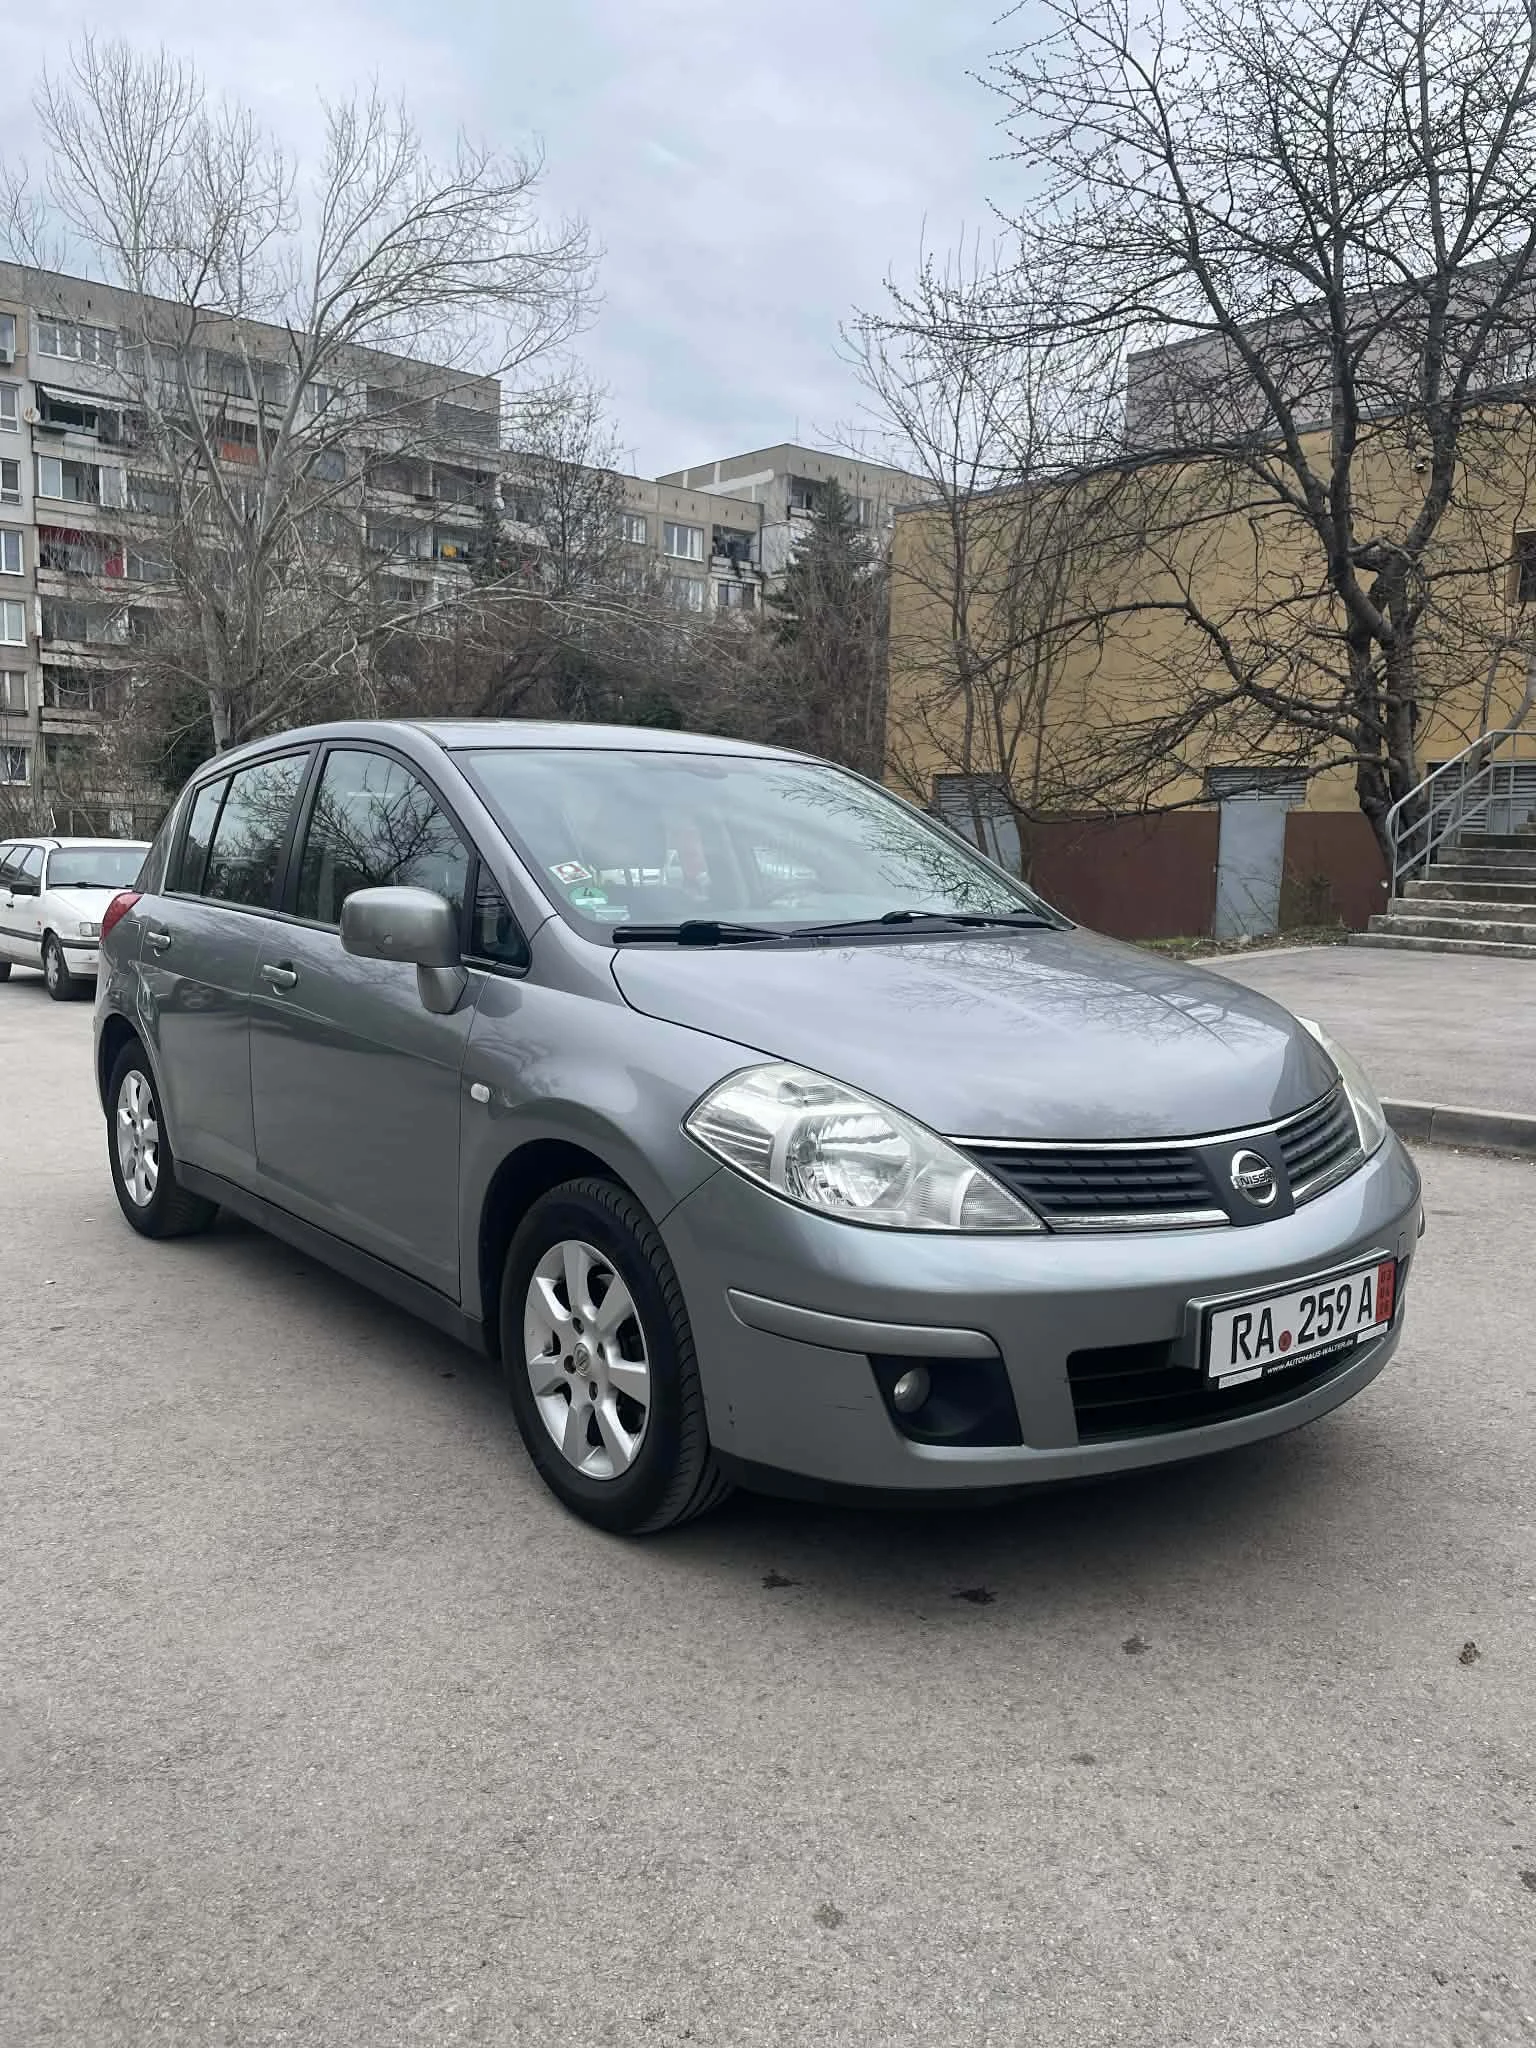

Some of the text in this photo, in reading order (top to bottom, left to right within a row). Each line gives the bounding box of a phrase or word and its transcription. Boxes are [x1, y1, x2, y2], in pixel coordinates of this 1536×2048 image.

[1230, 1275, 1373, 1364] RA 259 A
